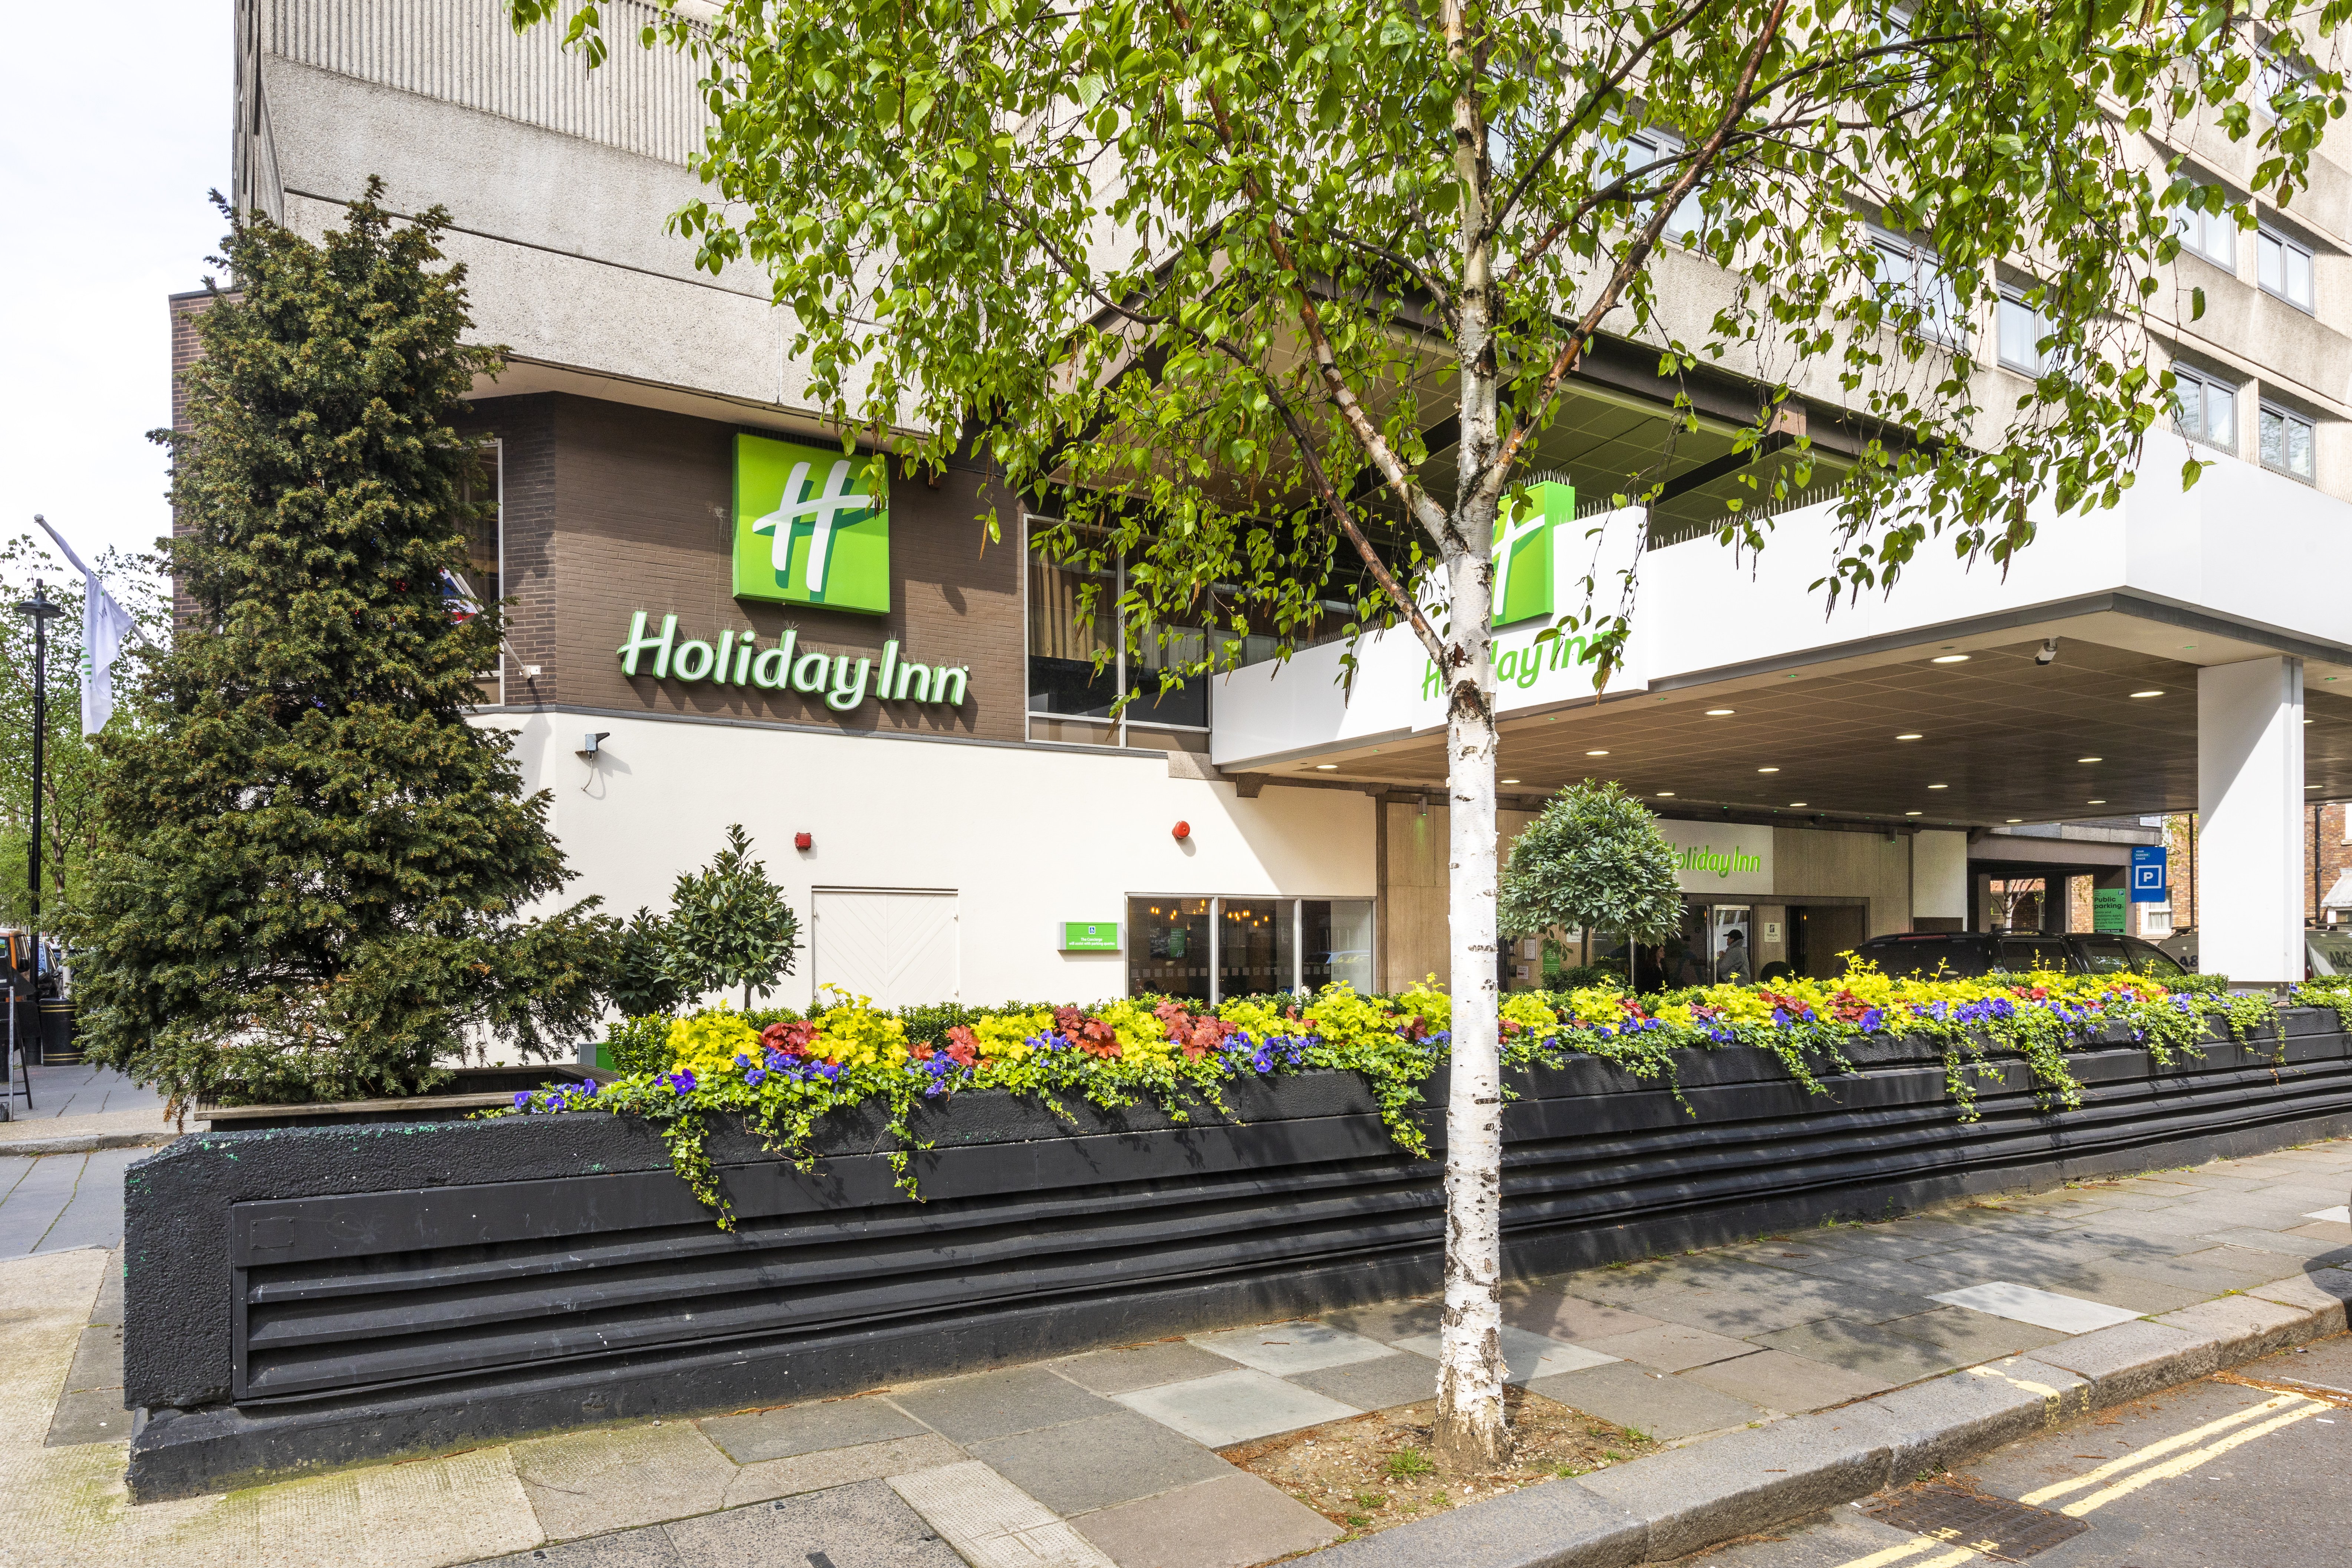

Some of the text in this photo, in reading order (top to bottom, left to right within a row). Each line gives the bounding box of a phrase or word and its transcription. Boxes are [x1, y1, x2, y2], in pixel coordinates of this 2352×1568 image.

[617, 611, 969, 711] Holiday Inn
[1733, 845, 1760, 872] Inn
[2144, 872, 2154, 882] P
